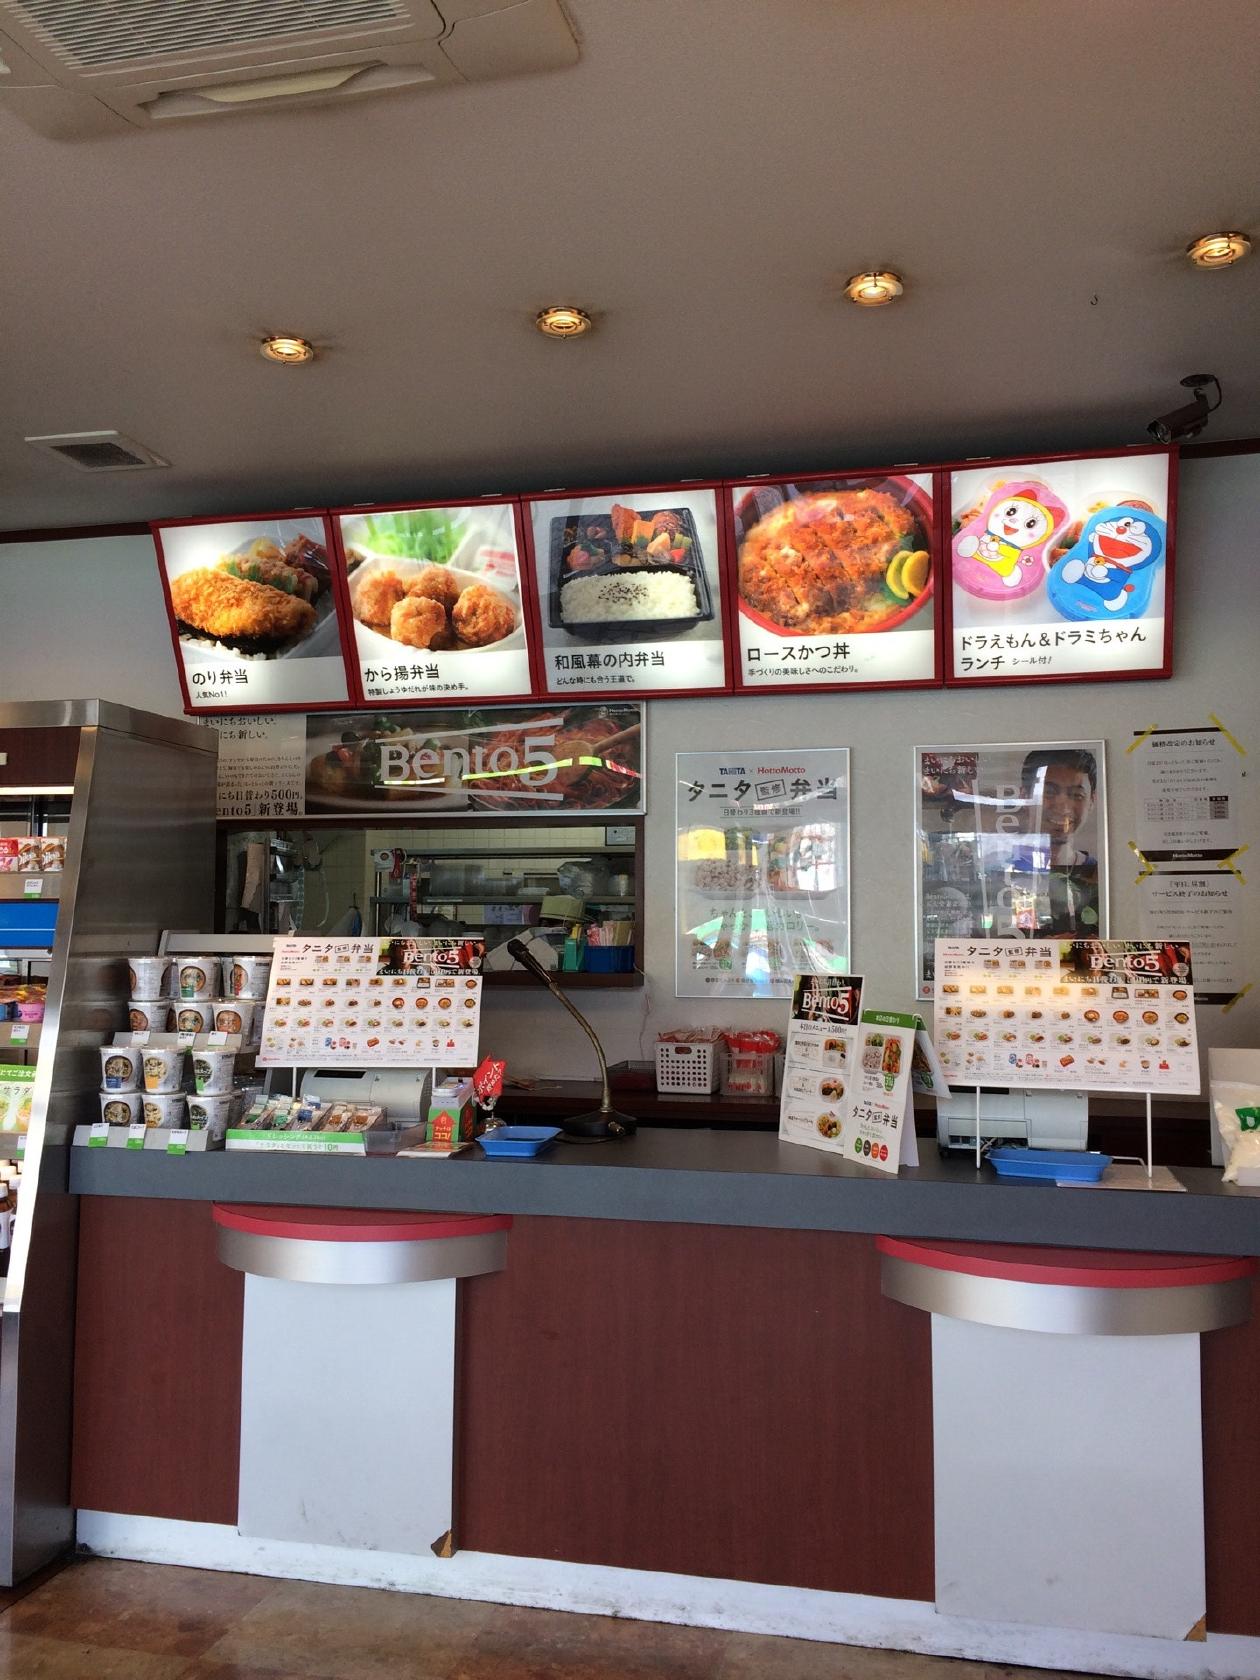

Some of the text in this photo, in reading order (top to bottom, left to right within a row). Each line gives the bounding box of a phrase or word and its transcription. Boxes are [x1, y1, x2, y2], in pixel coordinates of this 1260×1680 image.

[961, 627, 1147, 651] ドラえもん&ドラミちゃん
[555, 651, 665, 670] 和風幕の内弁当
[747, 642, 850, 661] ロースかつ丼
[748, 665, 859, 676] 手づくりの美味しさへのこだわり。
[961, 655, 1005, 671] ランチ
[192, 668, 249, 685] のり弁当
[364, 663, 440, 682] から揚弁当
[556, 675, 636, 685] どんな時にも合う王道で。
[367, 682, 469, 696] 特製しょうゆだれが味の決め手。
[380, 734, 558, 787] Bento5
